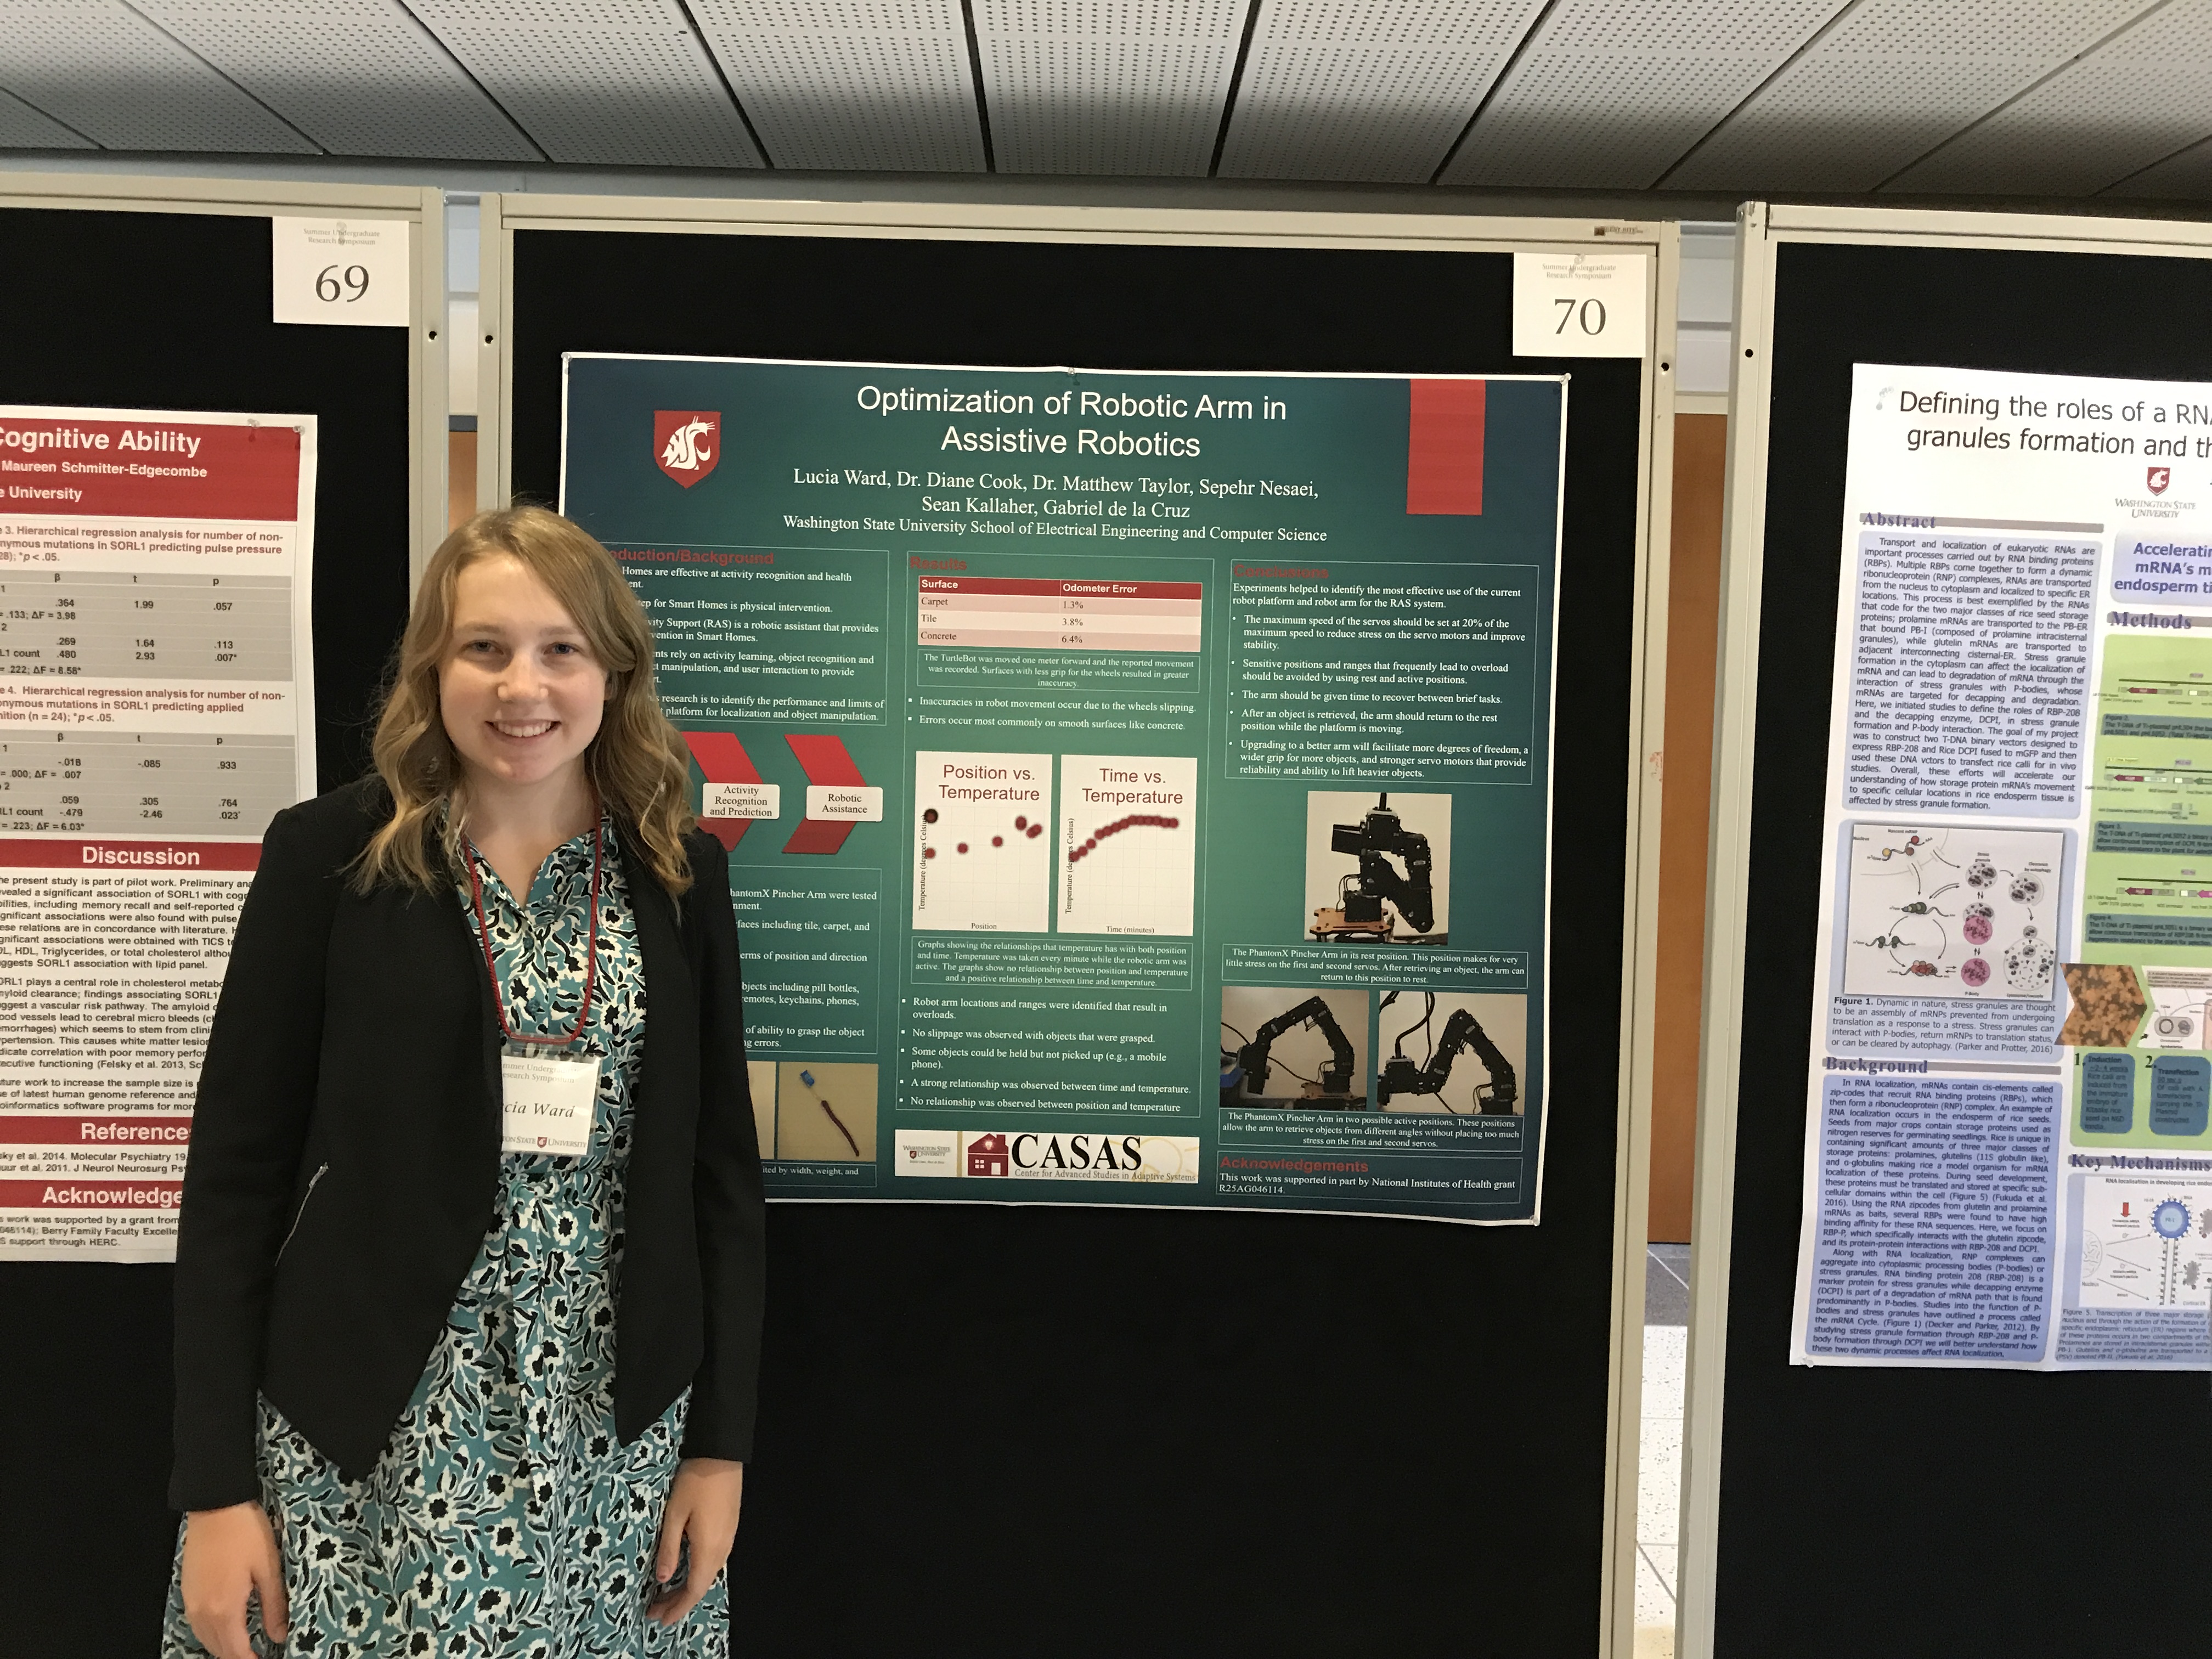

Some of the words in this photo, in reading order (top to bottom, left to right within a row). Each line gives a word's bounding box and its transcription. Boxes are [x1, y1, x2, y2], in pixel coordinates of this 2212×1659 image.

[315, 264, 369, 302] 69
[1555, 298, 1606, 335] 70
[857, 386, 1032, 416] Optimization
[1044, 391, 1072, 414] of
[1081, 391, 1187, 417] Robotic
[1194, 394, 1252, 419] Arm
[1264, 396, 1285, 420] in
[1900, 391, 1999, 420] Defining
[2009, 395, 2046, 417] the
[2057, 398, 2112, 420] roles
[2122, 401, 2145, 421] of
[2153, 407, 2165, 422] a
[2176, 404, 2212, 425] RN
[0, 426, 109, 453] ognitive
[117, 430, 201, 458] Ability
[940, 426, 1066, 453] Assistive
[1078, 429, 1200, 456] Robotics
[1908, 426, 2010, 450] granules
[2020, 427, 2134, 454] formation
[2144, 435, 2187, 456] and
[2, 460, 56, 472] Maureen
[61, 461, 207, 478] Schmitter-Edgecombe
[793, 468, 839, 484] Lucia
[843, 470, 891, 488] Ward,
[897, 471, 921, 486] Dr.
[927, 472, 974, 488] Diane
[979, 473, 1026, 492] Cook,
[1032, 475, 1056, 490] Dr.
[1062, 476, 1133, 492] Matthew
[1138, 477, 1193, 496] Taylor,
[1199, 478, 1255, 498] Sepehr
[1259, 480, 1318, 499] Nesaei,
[9, 486, 82, 502] University
[922, 496, 960, 511] Sean
[966, 497, 1037, 517] Kallaher,
[1043, 499, 1103, 515] Gabriel
[1108, 501, 1126, 516] de
[1132, 501, 1146, 516] la
[1151, 502, 1190, 517] Cruz
[1863, 512, 1936, 528] Abstract
[783, 515, 859, 532] Washington
[864, 517, 895, 530] State
[899, 518, 967, 535] University
[970, 520, 1014, 533] School
[1019, 522, 1034, 534] of
[1036, 522, 1097, 535] Electrical
[1101, 524, 1178, 541] Engineering
[1183, 526, 1205, 538] and
[1210, 526, 1273, 542] Computer
[1278, 528, 1327, 541] Science
[910, 556, 967, 570] Results
[1234, 563, 1329, 578] Conclusions
[922, 580, 958, 590] Surface
[1063, 583, 1110, 592] Odometer
[1113, 584, 1137, 592] Error
[1233, 583, 1286, 594] Experiments
[1289, 584, 1318, 595] helped
[1331, 585, 1364, 596] identify
[1367, 585, 1380, 594] the
[1406, 586, 1444, 595] effective
[1463, 586, 1474, 595] of
[1475, 587, 1488, 596] the
[2114, 578, 2198, 594] endosperm
[55, 599, 74, 607] .364
[213, 602, 232, 611] .057
[921, 597, 948, 607] Carpet
[921, 614, 937, 623] Tile
[1062, 618, 1083, 626] 3.8%
[2111, 611, 2192, 629] Methods
[921, 631, 957, 641] Concrete
[944, 764, 1007, 779] Position
[1013, 769, 1034, 780] vs.
[1099, 768, 1138, 782] Time
[1144, 772, 1165, 783] vs.
[724, 786, 759, 796] Activity
[828, 793, 861, 802] Robotic
[938, 785, 1039, 802] Temperature
[1082, 788, 1182, 805] Temperature
[715, 796, 767, 806] Recognition
[822, 804, 867, 813] Assistance
[1849, 795, 1880, 805] affected
[1883, 797, 1893, 806] by
[1920, 799, 1949, 808] granule
[1951, 800, 1990, 809] formation.
[729, 808, 771, 816] Prediction
[83, 846, 199, 865] Discussion
[918, 871, 927, 911] Temperature
[37, 958, 69, 967] SORL1
[74, 960, 128, 968] association
[156, 960, 176, 970] lipid
[179, 961, 207, 970] panel.
[1834, 996, 1862, 1006] Figure
[1876, 998, 1909, 1007] Dynamic
[1921, 1000, 1948, 1009] nature,
[1976, 1001, 2008, 1010] granules
[2026, 1003, 2055, 1013] thought
[1826, 1056, 1928, 1075] Background
[503, 1101, 527, 1114] cia
[534, 1103, 575, 1118] Ward
[81, 1122, 191, 1140] Reference
[1012, 1134, 1141, 1170] CASAS
[1220, 1156, 1368, 1173] Acknowledgements
[2072, 1154, 2102, 1172] Key
[2110, 1155, 2212, 1171] Mechanisms
[1014, 1169, 1040, 1177] Center
[1042, 1169, 1052, 1177] for
[1054, 1169, 1091, 1178] Advanced
[1093, 1171, 1120, 1179] Studies
[1131, 1171, 1165, 1182] Adaptive
[1166, 1172, 1195, 1183] Systems
